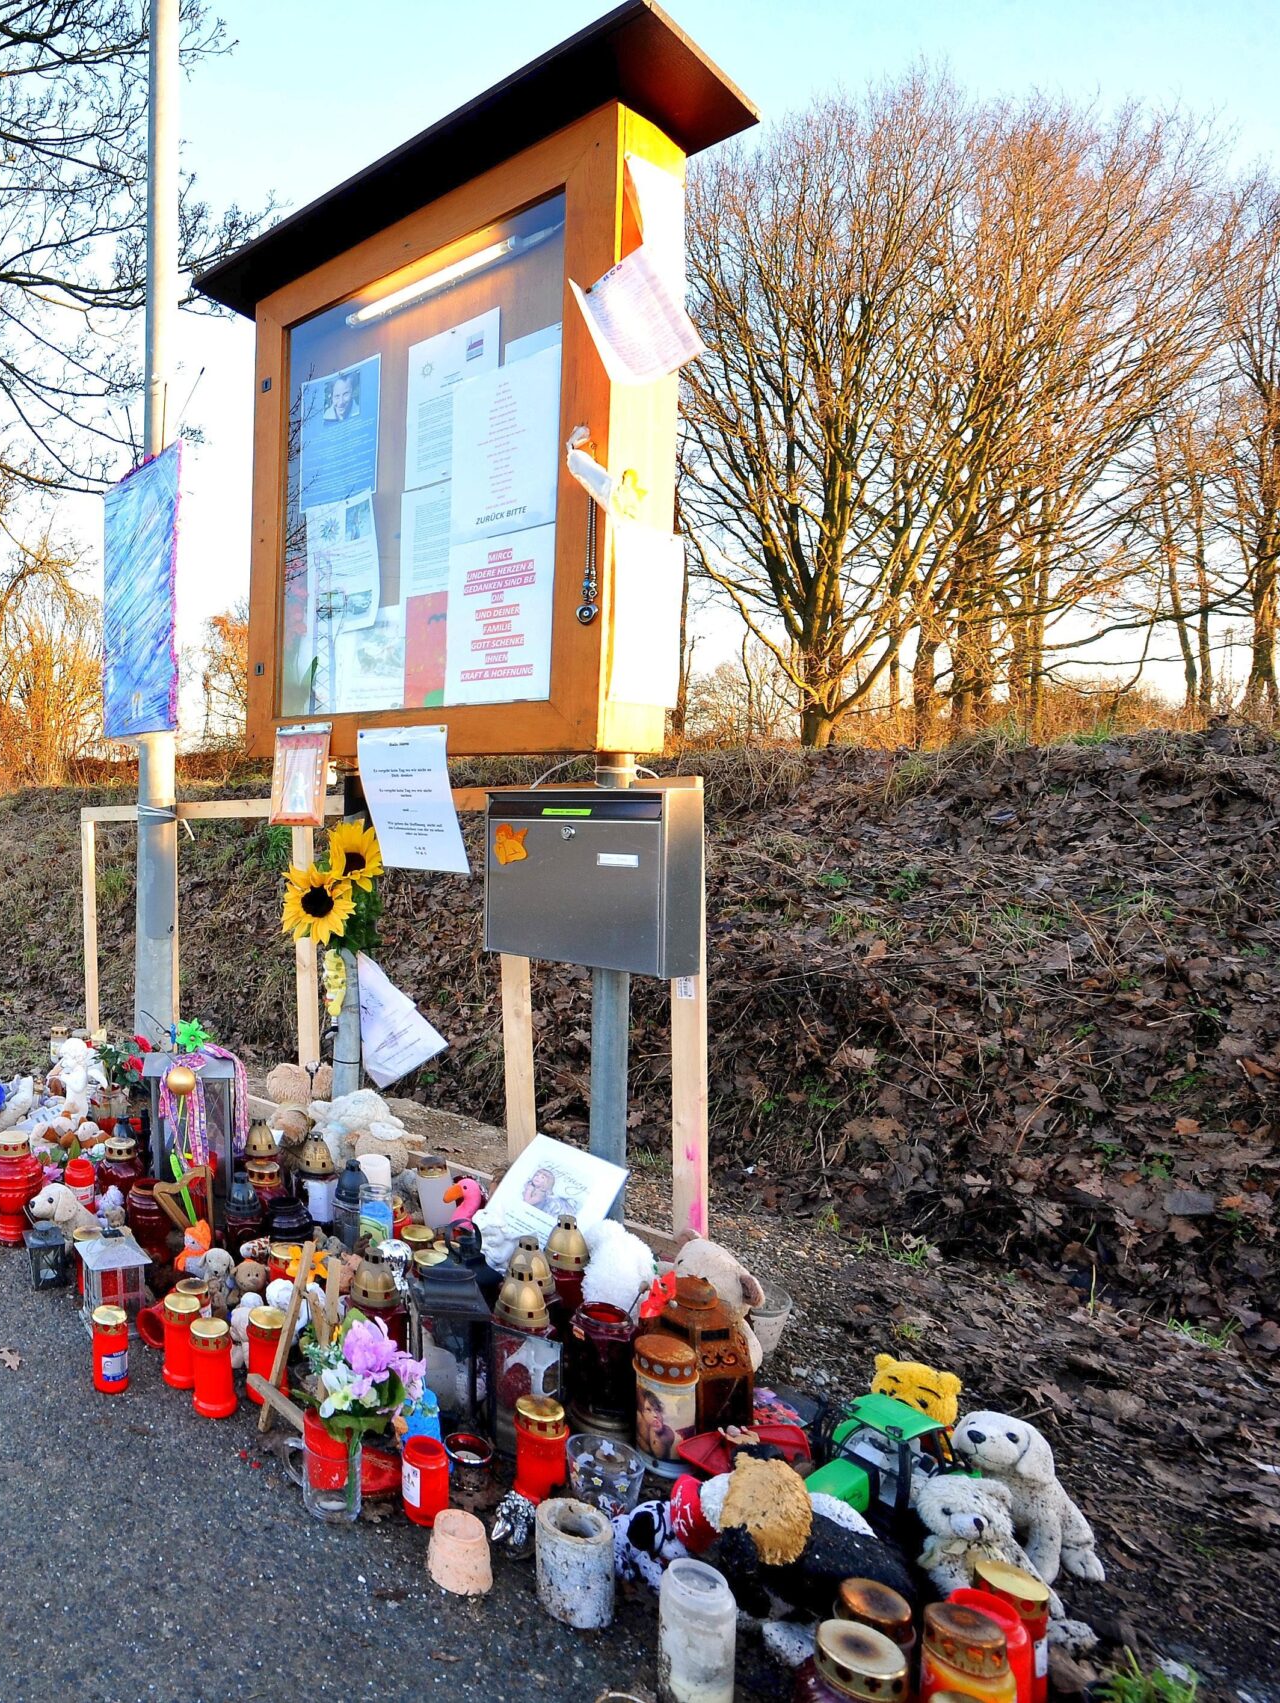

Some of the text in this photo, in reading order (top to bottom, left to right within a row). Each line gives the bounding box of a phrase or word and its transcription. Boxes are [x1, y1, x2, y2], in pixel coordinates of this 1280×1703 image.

[475, 505, 528, 525] ZURÜCK BITTE
[488, 550, 513, 562] MIRCO
[497, 563, 526, 575] HERZEN
[527, 561, 534, 570] &
[464, 581, 503, 593] GEDANKEN
[503, 577, 522, 588] SIND
[491, 593, 504, 602] DIR
[475, 606, 520, 620] UND DEINER
[483, 622, 512, 634] FAMILIE
[471, 637, 525, 650] GOTT SCHENKE
[485, 653, 508, 663] IHNEN
[461, 666, 534, 681] KRAFT & HOFFNUNG
